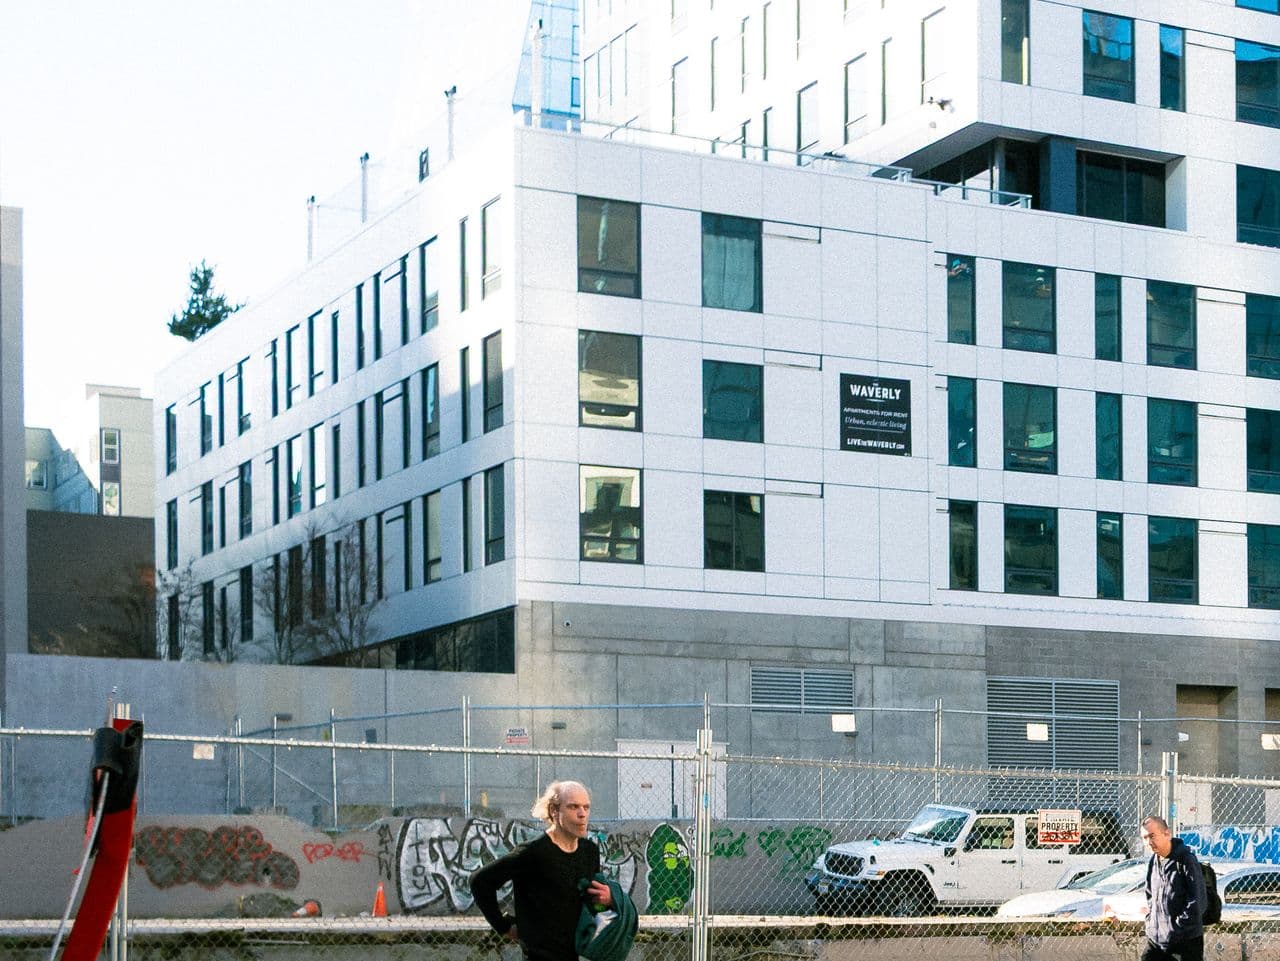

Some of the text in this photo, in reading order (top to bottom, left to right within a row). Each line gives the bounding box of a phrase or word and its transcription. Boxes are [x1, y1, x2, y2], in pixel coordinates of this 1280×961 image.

[849, 384, 901, 400] WAVERLY
[843, 407, 880, 416] APARTMENTS
[1041, 822, 1078, 831] PROPERTY
